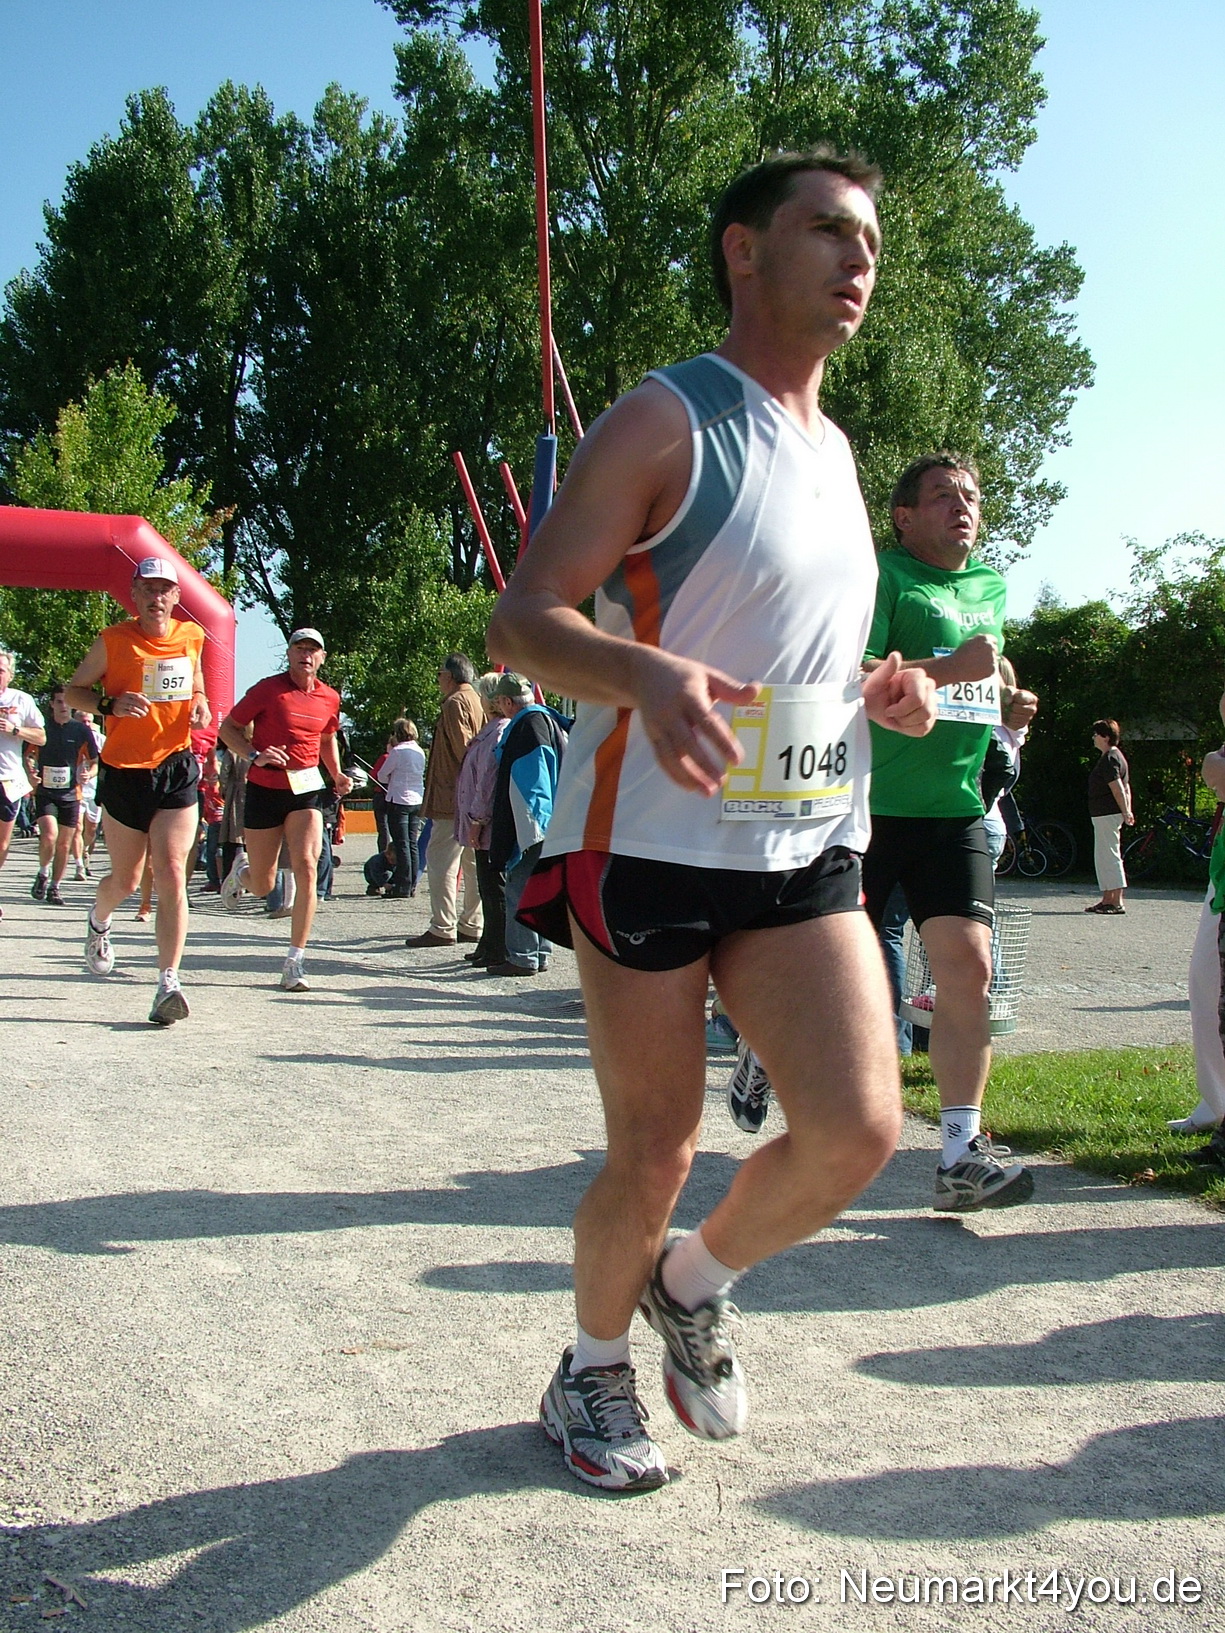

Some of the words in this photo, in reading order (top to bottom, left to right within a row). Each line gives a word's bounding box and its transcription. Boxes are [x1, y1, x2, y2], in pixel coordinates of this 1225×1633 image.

[157, 663, 174, 672] Hans
[162, 676, 185, 690] 957
[952, 682, 995, 705] 2614
[778, 741, 848, 781] 1048
[724, 800, 783, 813] BOCK
